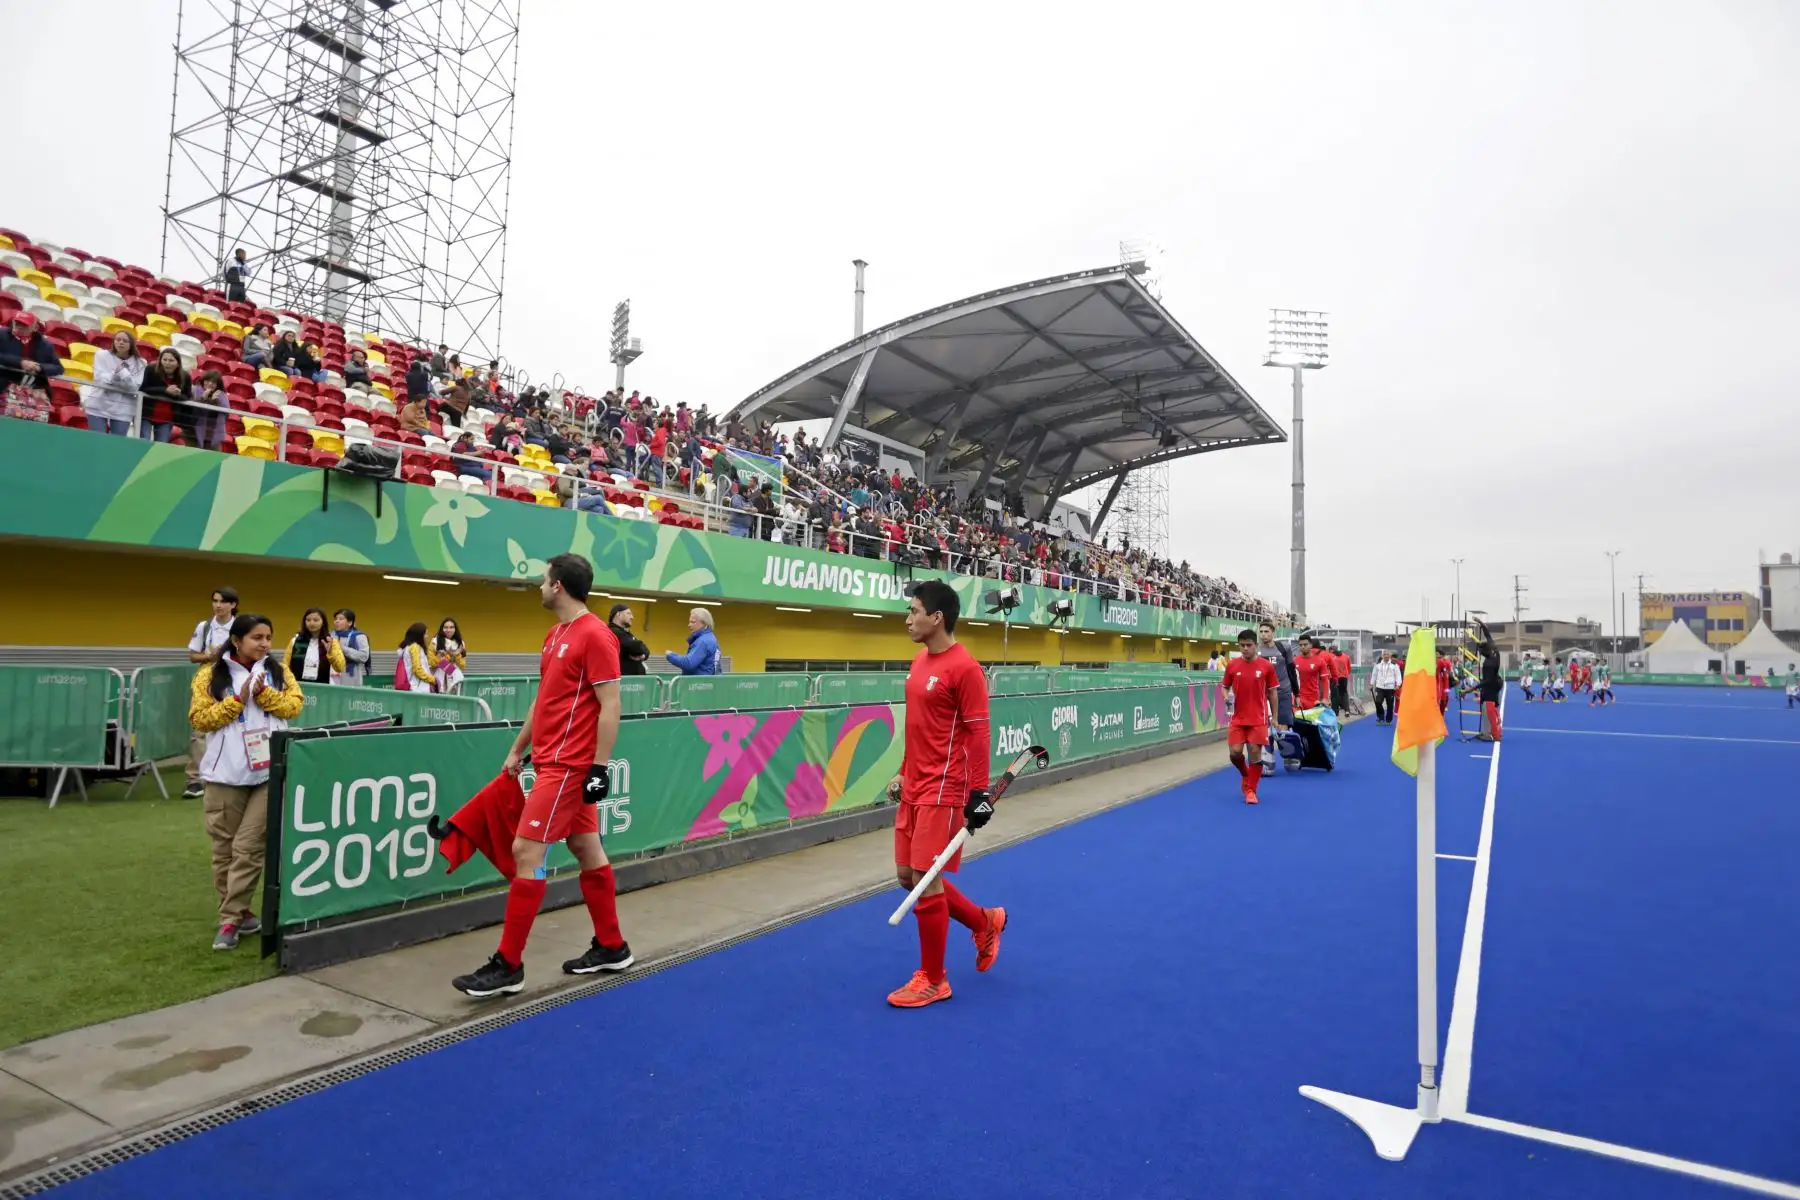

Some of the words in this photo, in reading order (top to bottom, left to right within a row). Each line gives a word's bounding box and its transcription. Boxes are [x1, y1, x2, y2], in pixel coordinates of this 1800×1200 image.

[761, 555, 864, 596] JUGAMOS
[1662, 593, 1743, 602] MAGISTER
[1268, 656, 1277, 664] 12
[1052, 705, 1078, 731] GLORIA
[1100, 712, 1124, 727] LATAM
[291, 824, 435, 896] 2019
